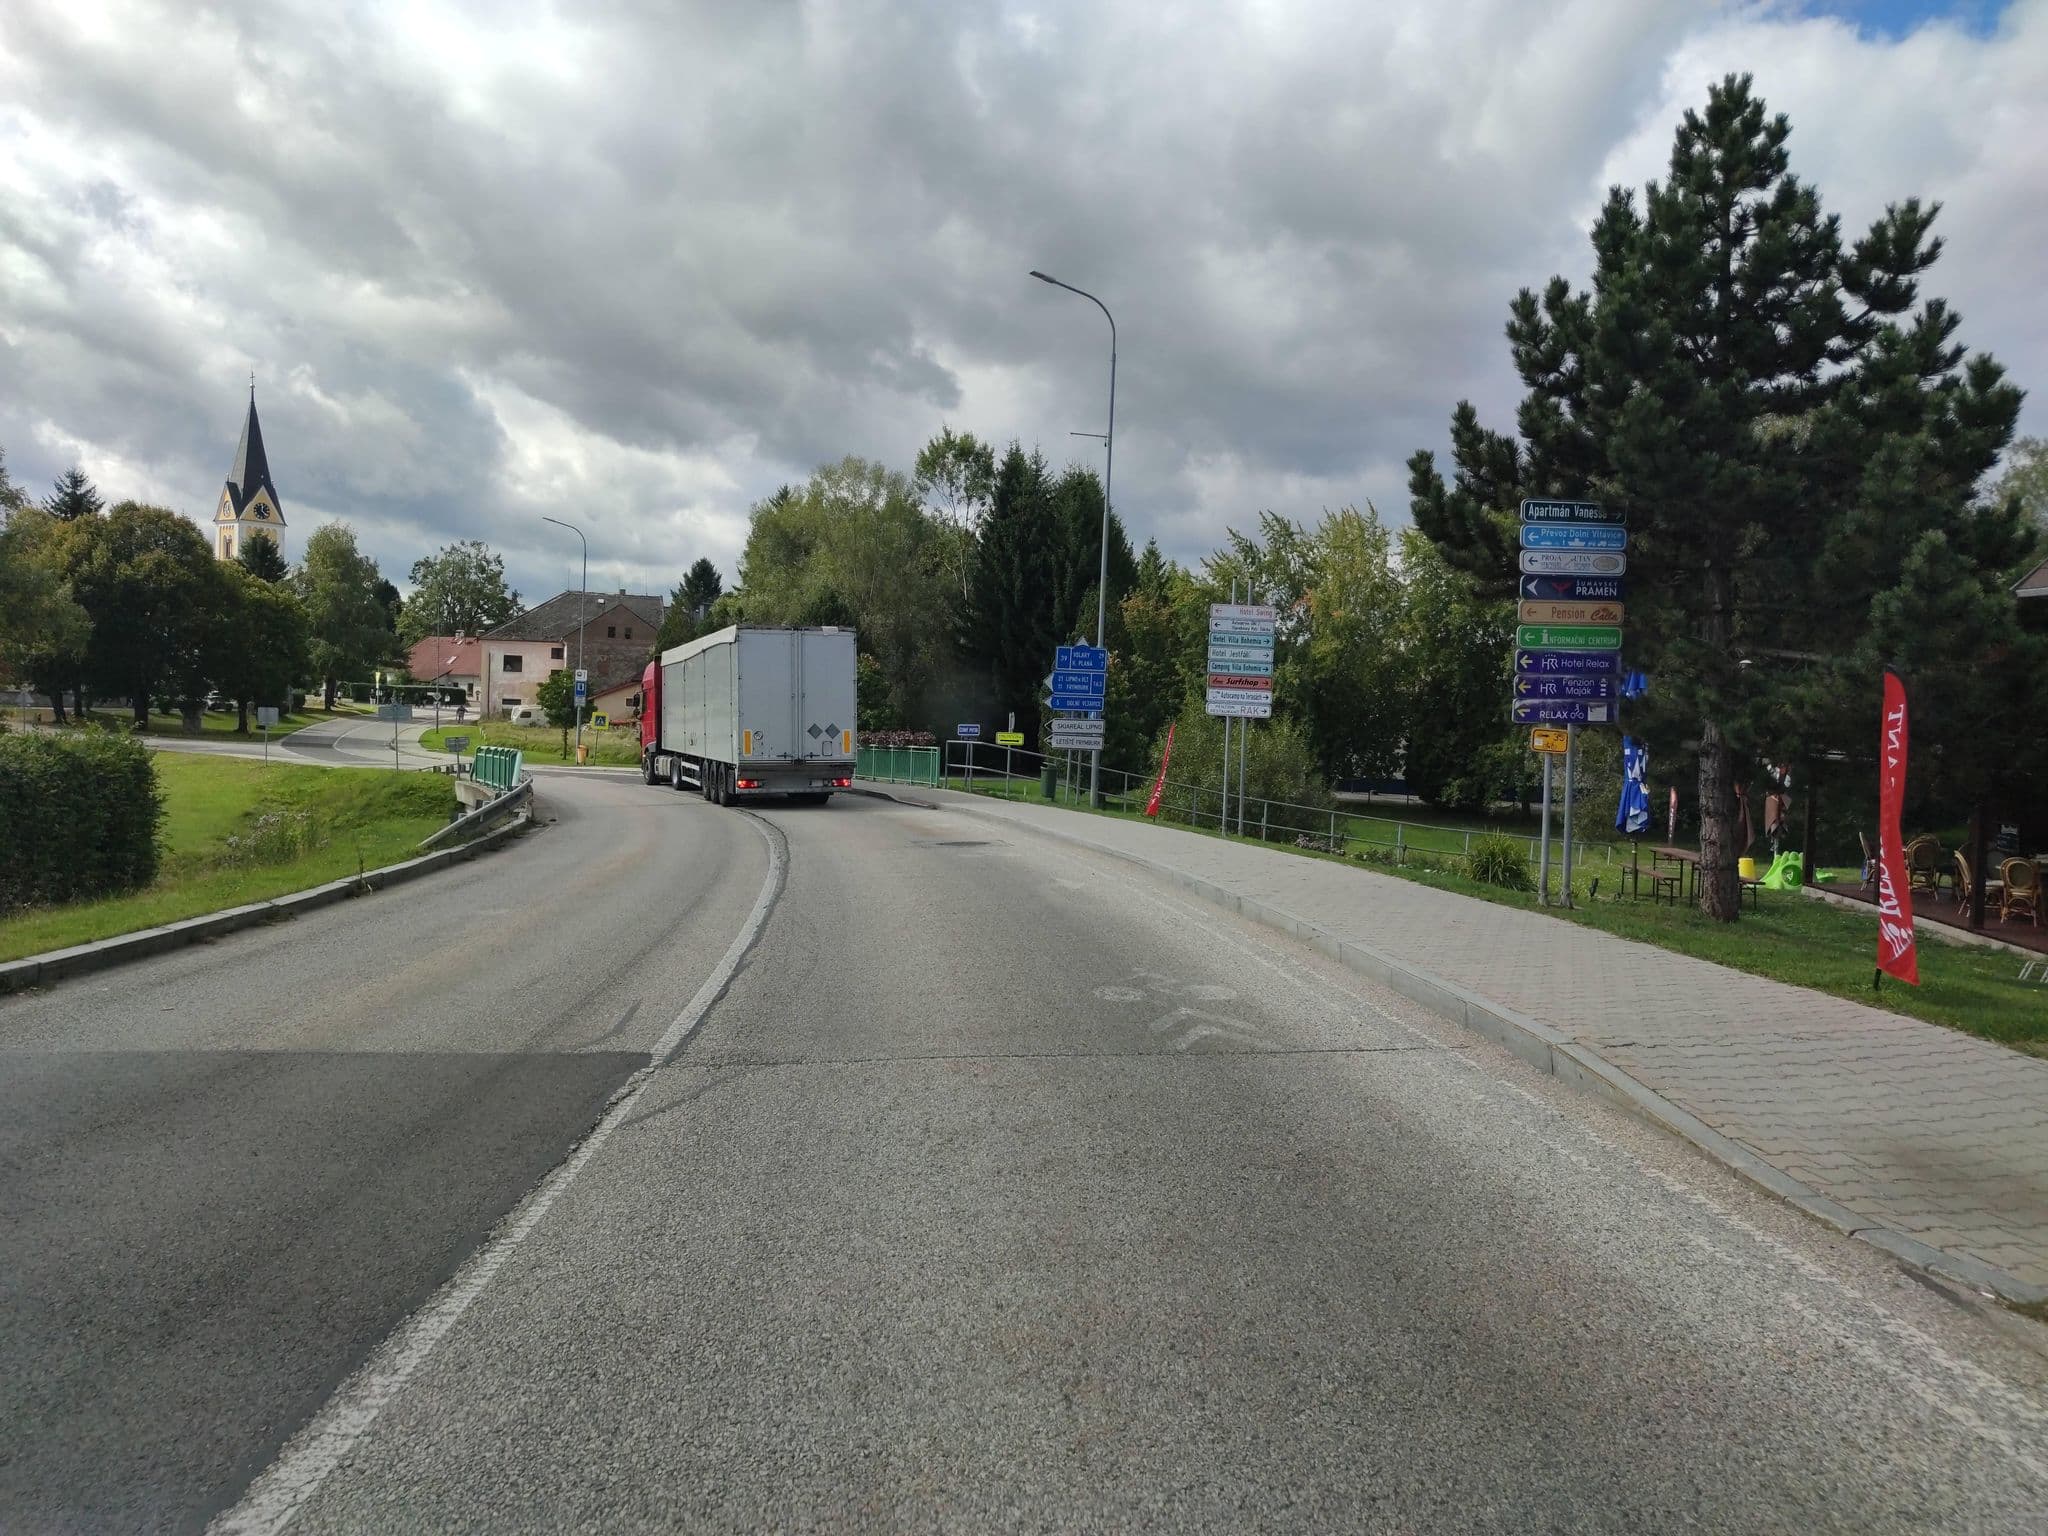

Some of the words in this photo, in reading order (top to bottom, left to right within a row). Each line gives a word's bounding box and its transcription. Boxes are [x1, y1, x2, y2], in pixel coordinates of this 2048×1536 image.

[1528, 504, 1569, 519] Apartmán
[1576, 587, 1617, 596] PRAMEN
[1552, 607, 1584, 619] Pension
[1588, 637, 1616, 645] CENTRUM
[1226, 678, 1258, 686] Surfshop
[1566, 687, 1591, 696] Maják
